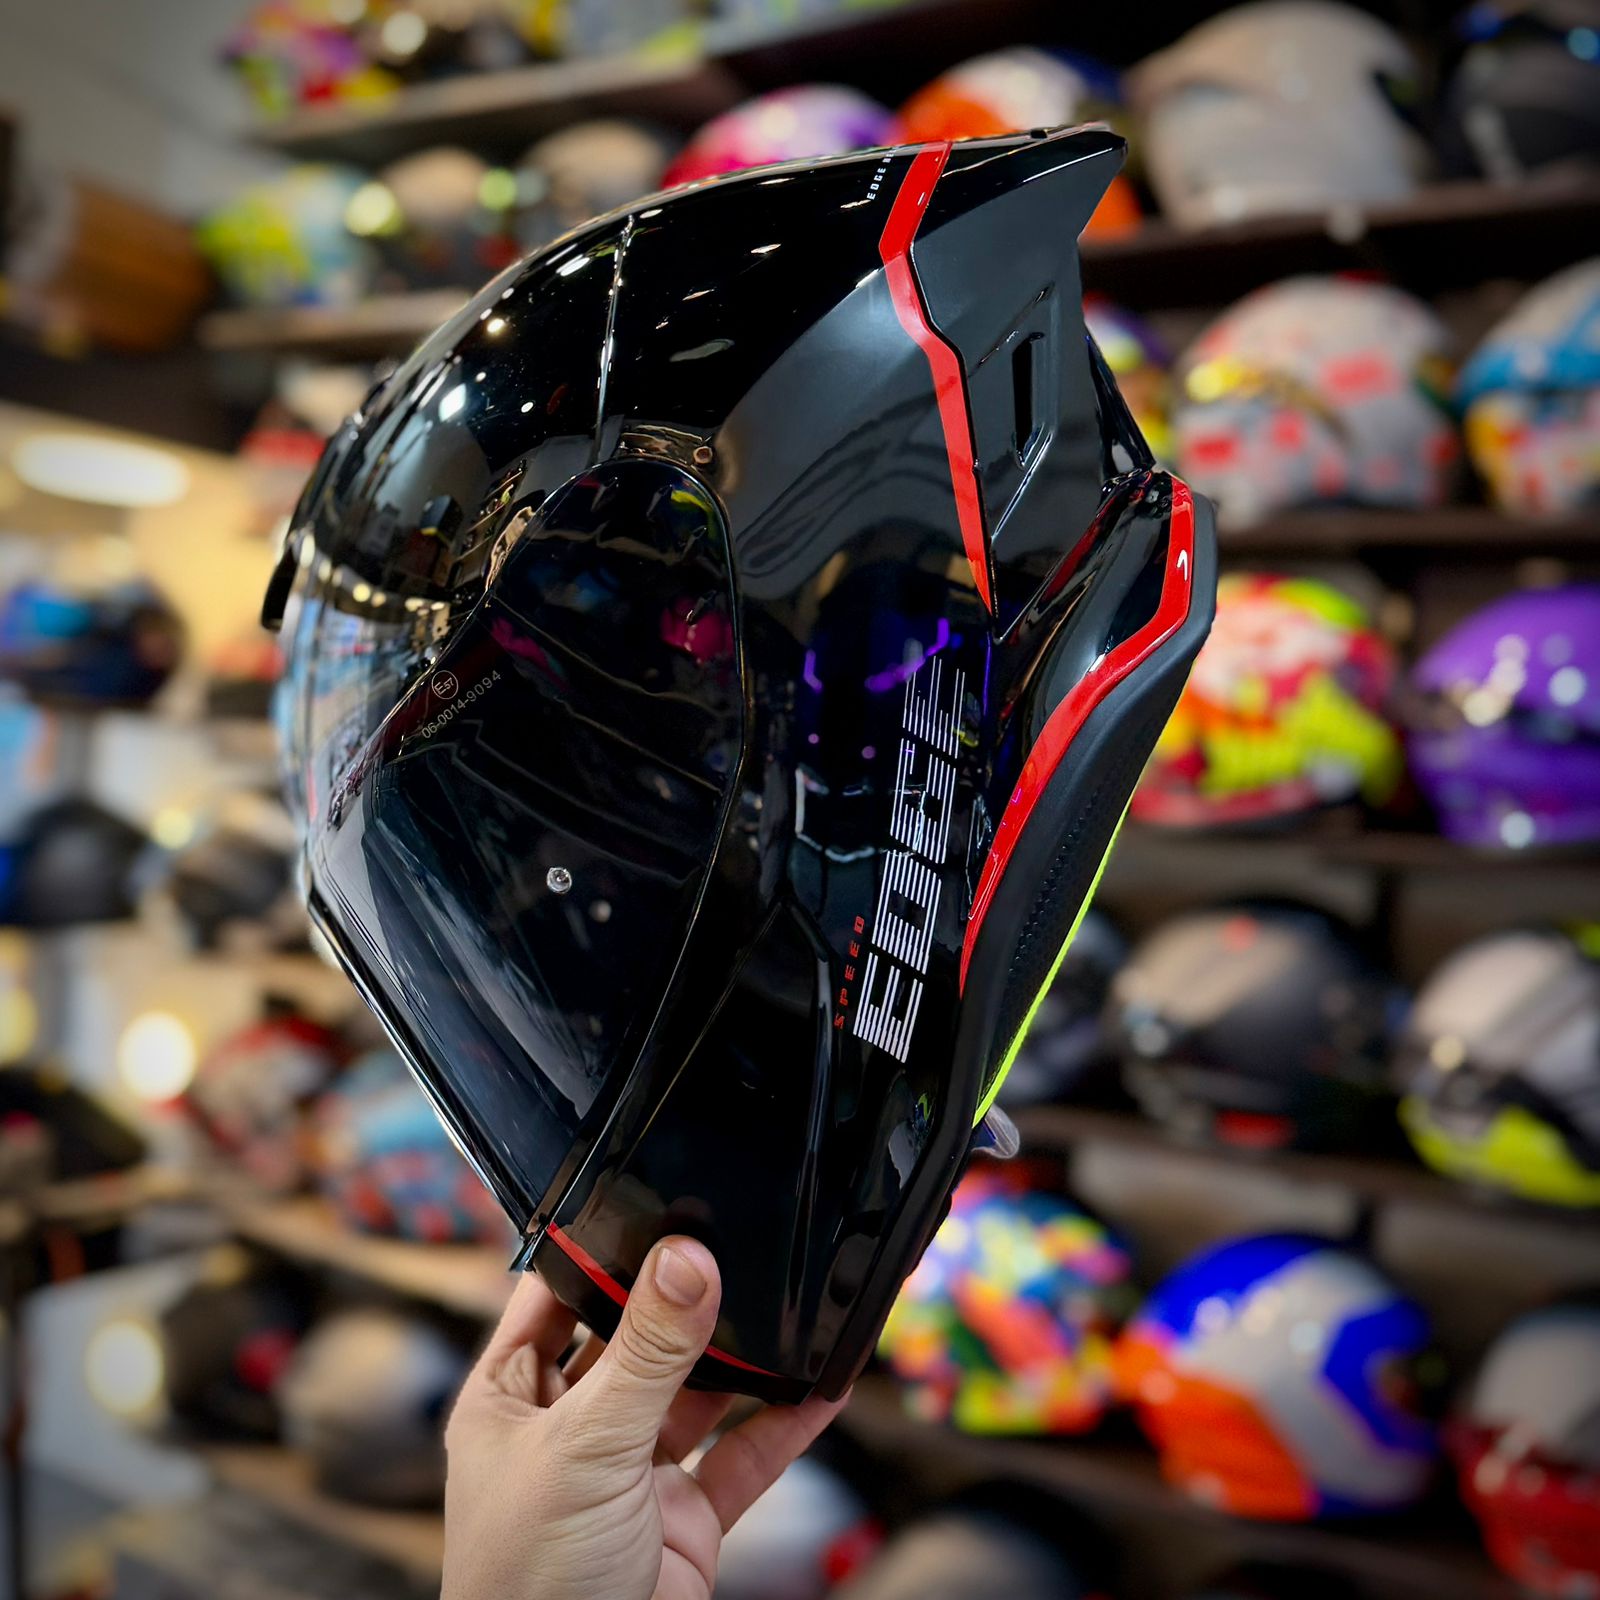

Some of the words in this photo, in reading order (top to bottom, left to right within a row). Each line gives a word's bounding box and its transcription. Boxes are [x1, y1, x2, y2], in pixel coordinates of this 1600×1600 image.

[866, 167, 887, 200] EDGE
[421, 670, 501, 739] 06-0014-9094
[433, 675, 456, 696] E57
[853, 655, 965, 1063] EDGE
[834, 915, 865, 1029] SPEED
